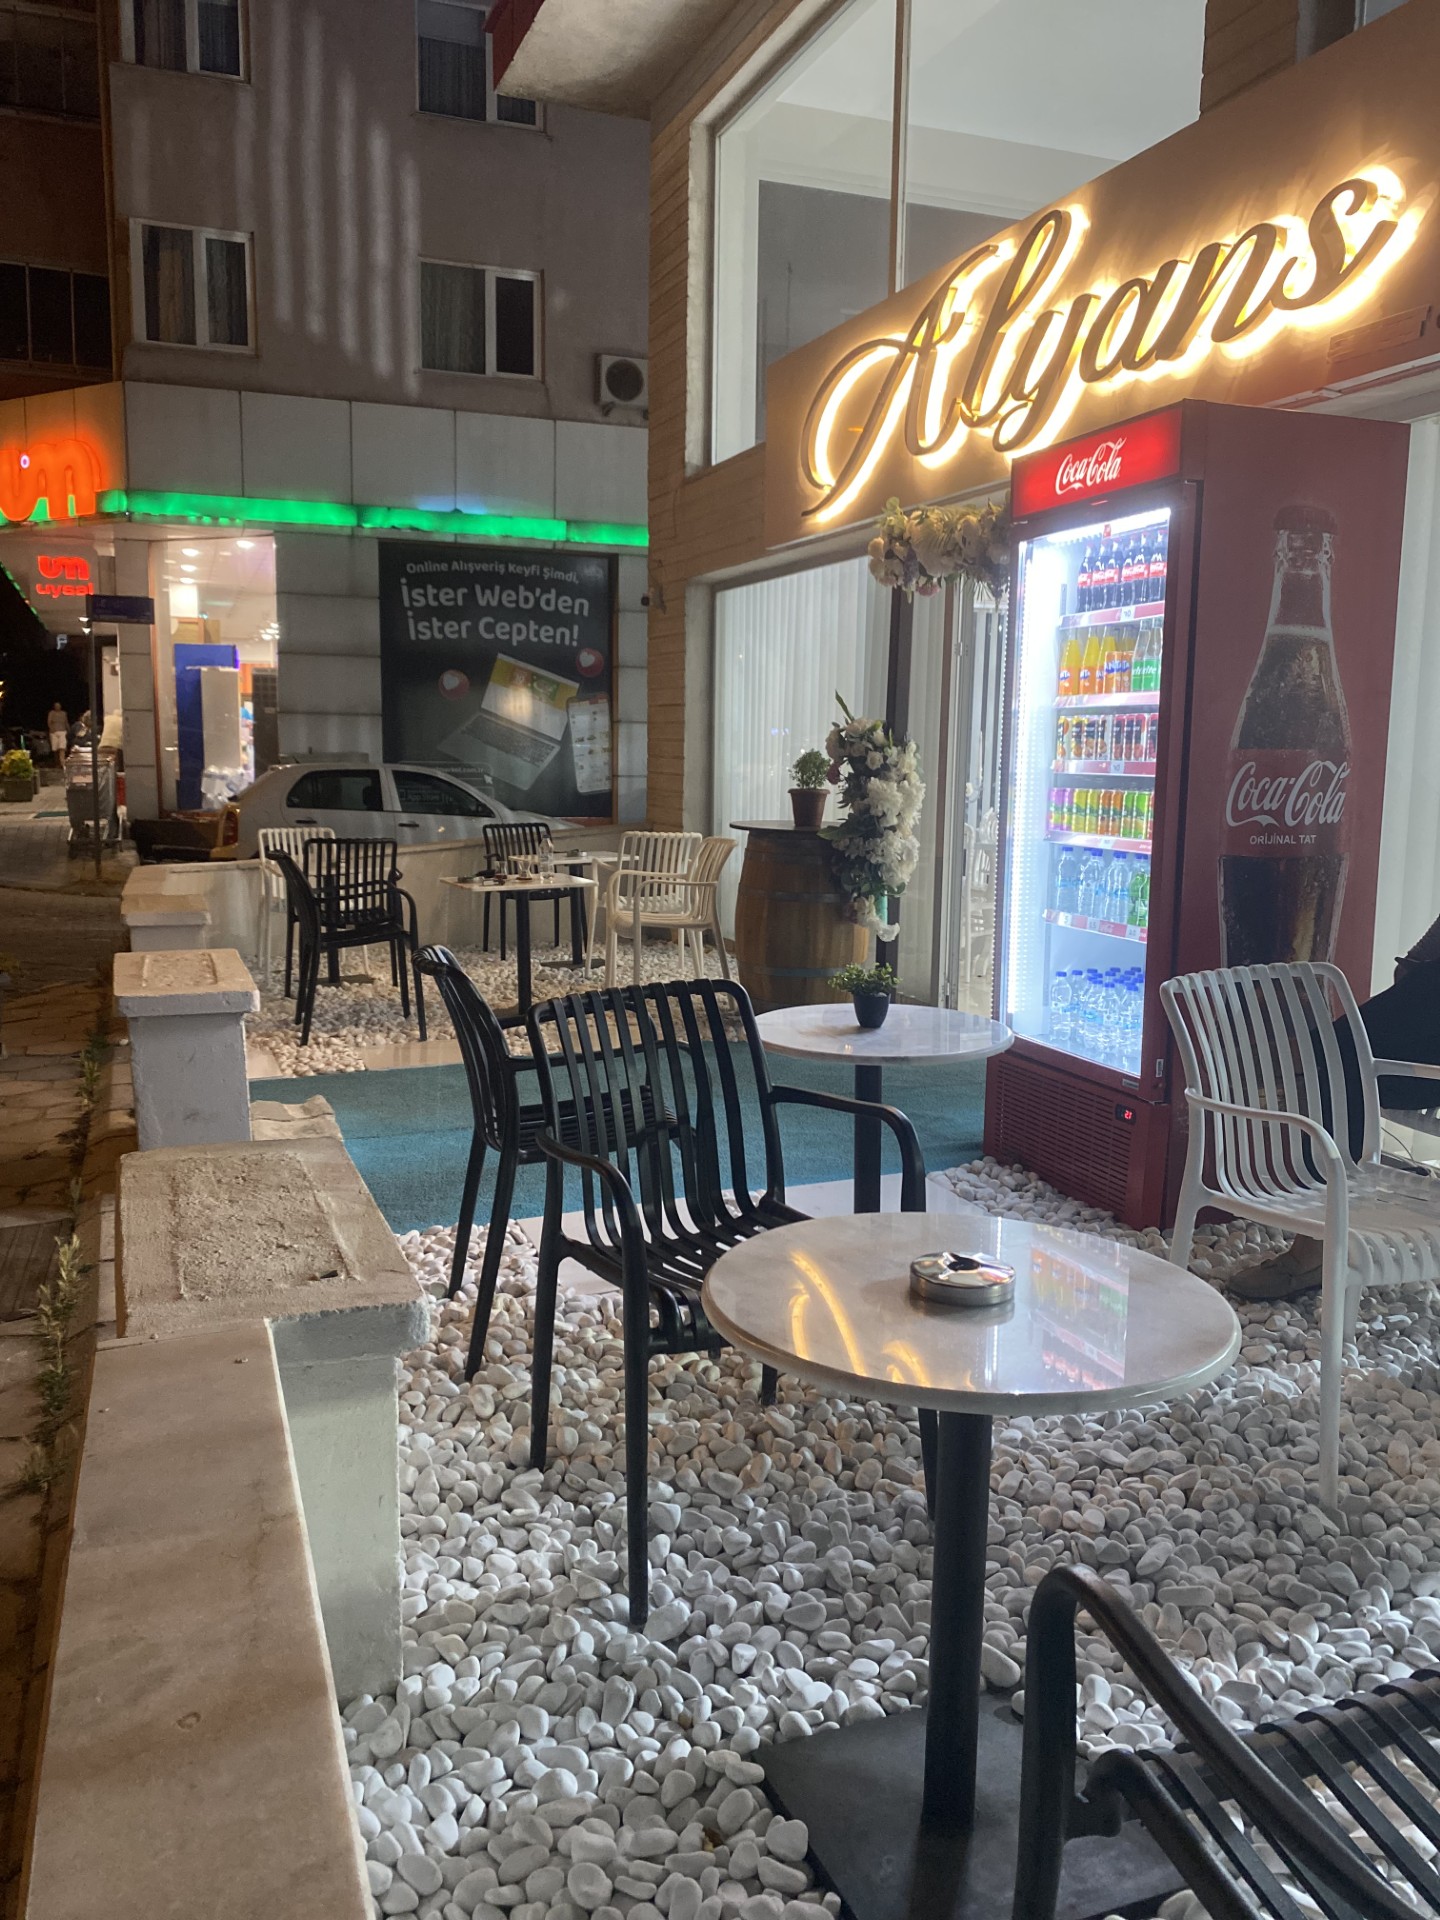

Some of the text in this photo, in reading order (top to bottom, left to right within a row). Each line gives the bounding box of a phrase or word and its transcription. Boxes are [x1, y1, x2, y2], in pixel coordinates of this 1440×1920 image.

[801, 177, 1402, 517] Alyans
[1055, 436, 1127, 495] Coca-Cola
[406, 560, 579, 584] Online Alışveriş Keyfi Şimdi,
[36, 582, 94, 598] uysal
[474, 583, 590, 617] Web'den
[478, 616, 579, 647] Cepten!
[1226, 760, 1351, 827] Coca-Cola
[1299, 834, 1317, 845] TAT
